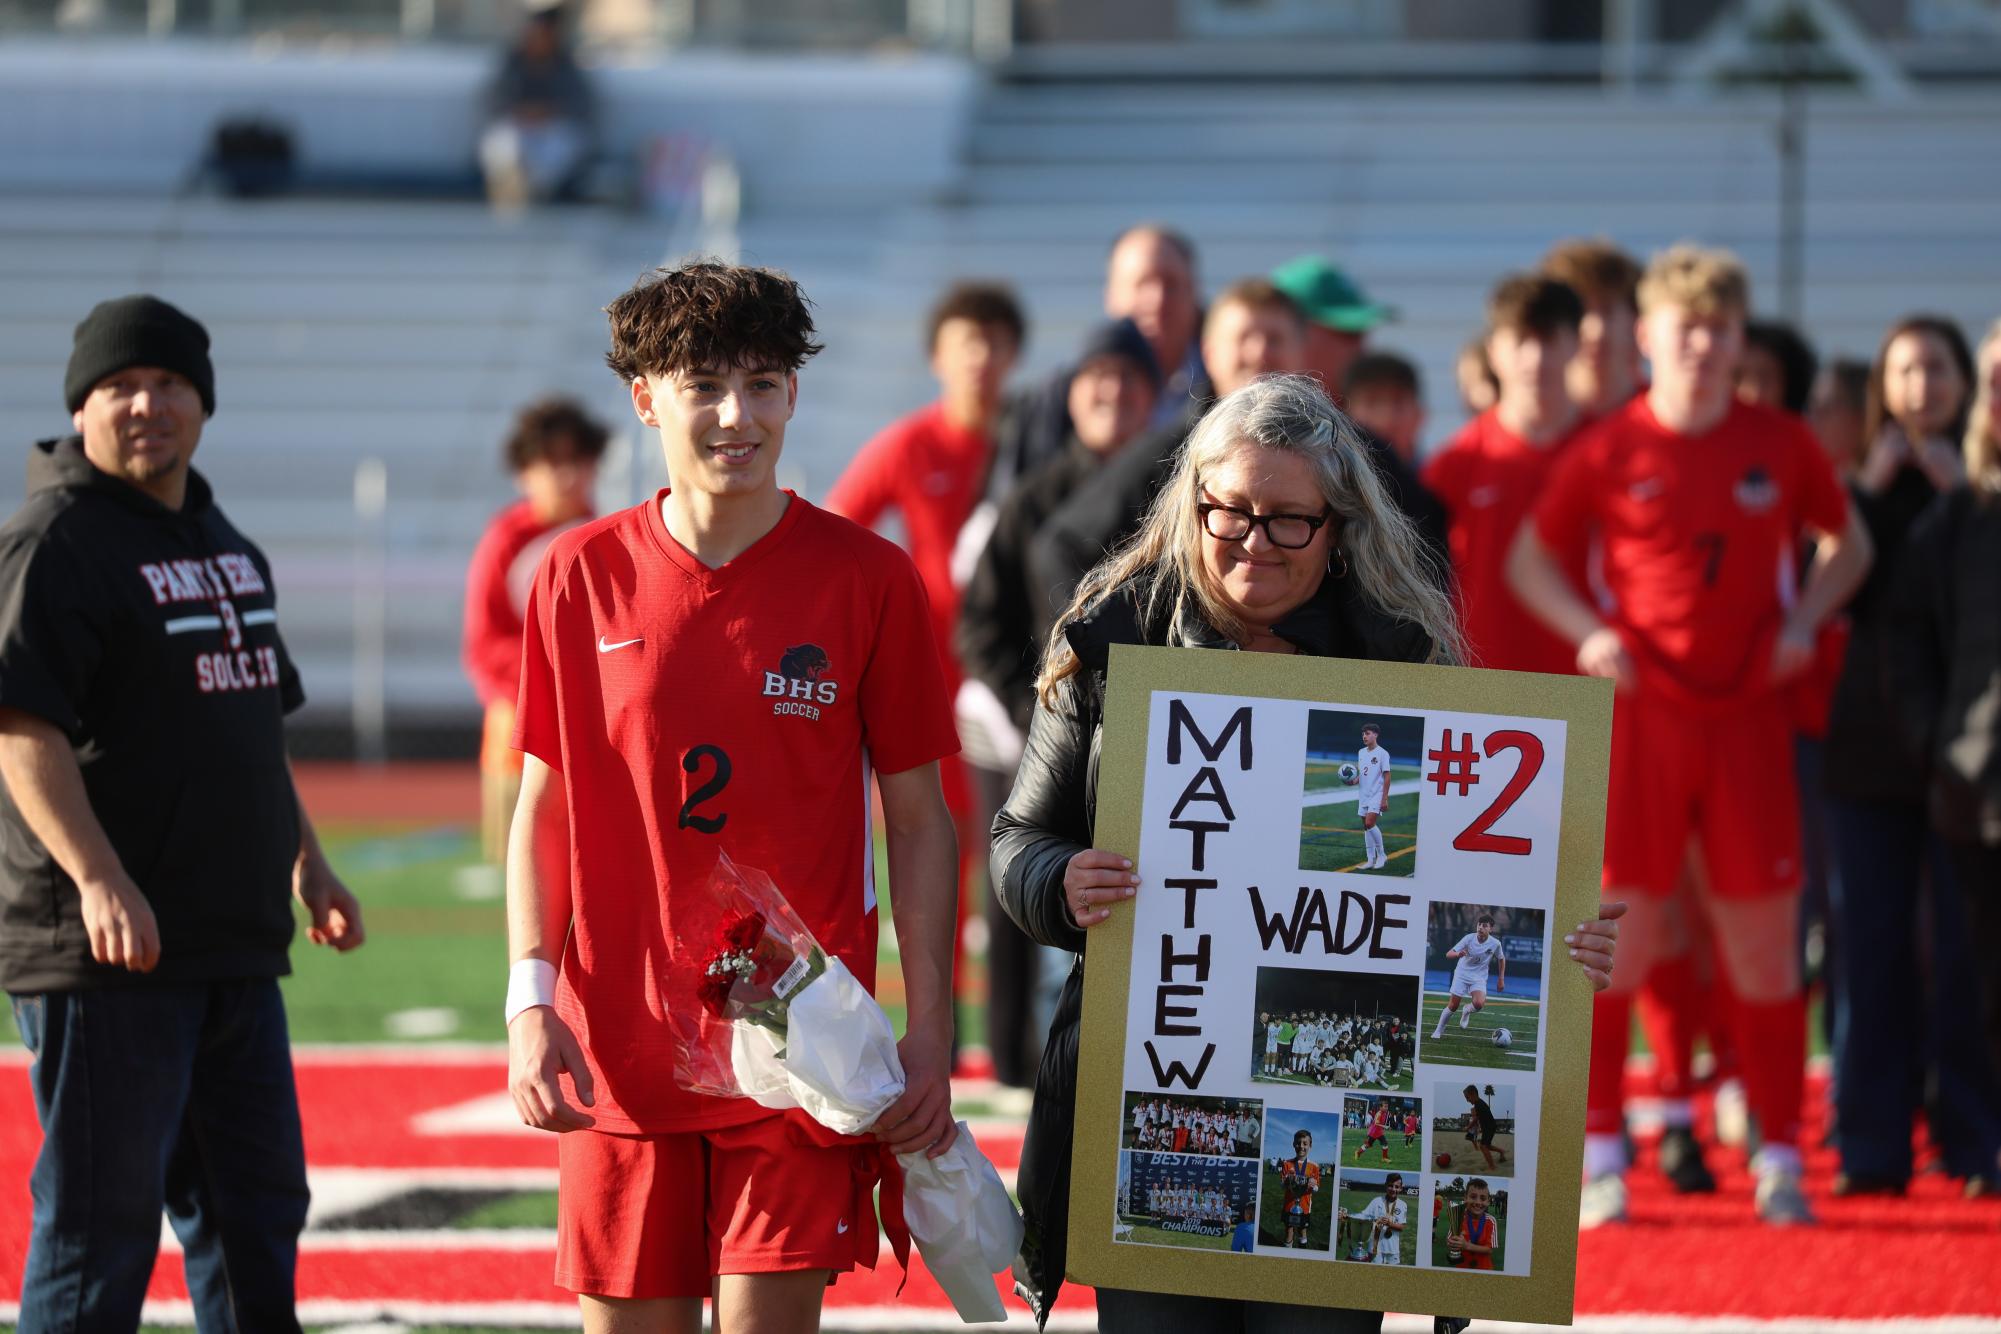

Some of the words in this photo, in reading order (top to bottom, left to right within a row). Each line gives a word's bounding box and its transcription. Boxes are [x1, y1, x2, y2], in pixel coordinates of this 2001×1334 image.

[763, 671, 837, 704] BHS
[773, 702, 820, 720] SOCCER
[679, 744, 731, 834] 2
[1427, 728, 1544, 855] #2
[1144, 698, 1252, 1090] MATTHEW
[1247, 886, 1411, 959] WADE
[1150, 1152, 1191, 1166] BEST
[1161, 1221, 1223, 1237] CHAMPIONS
